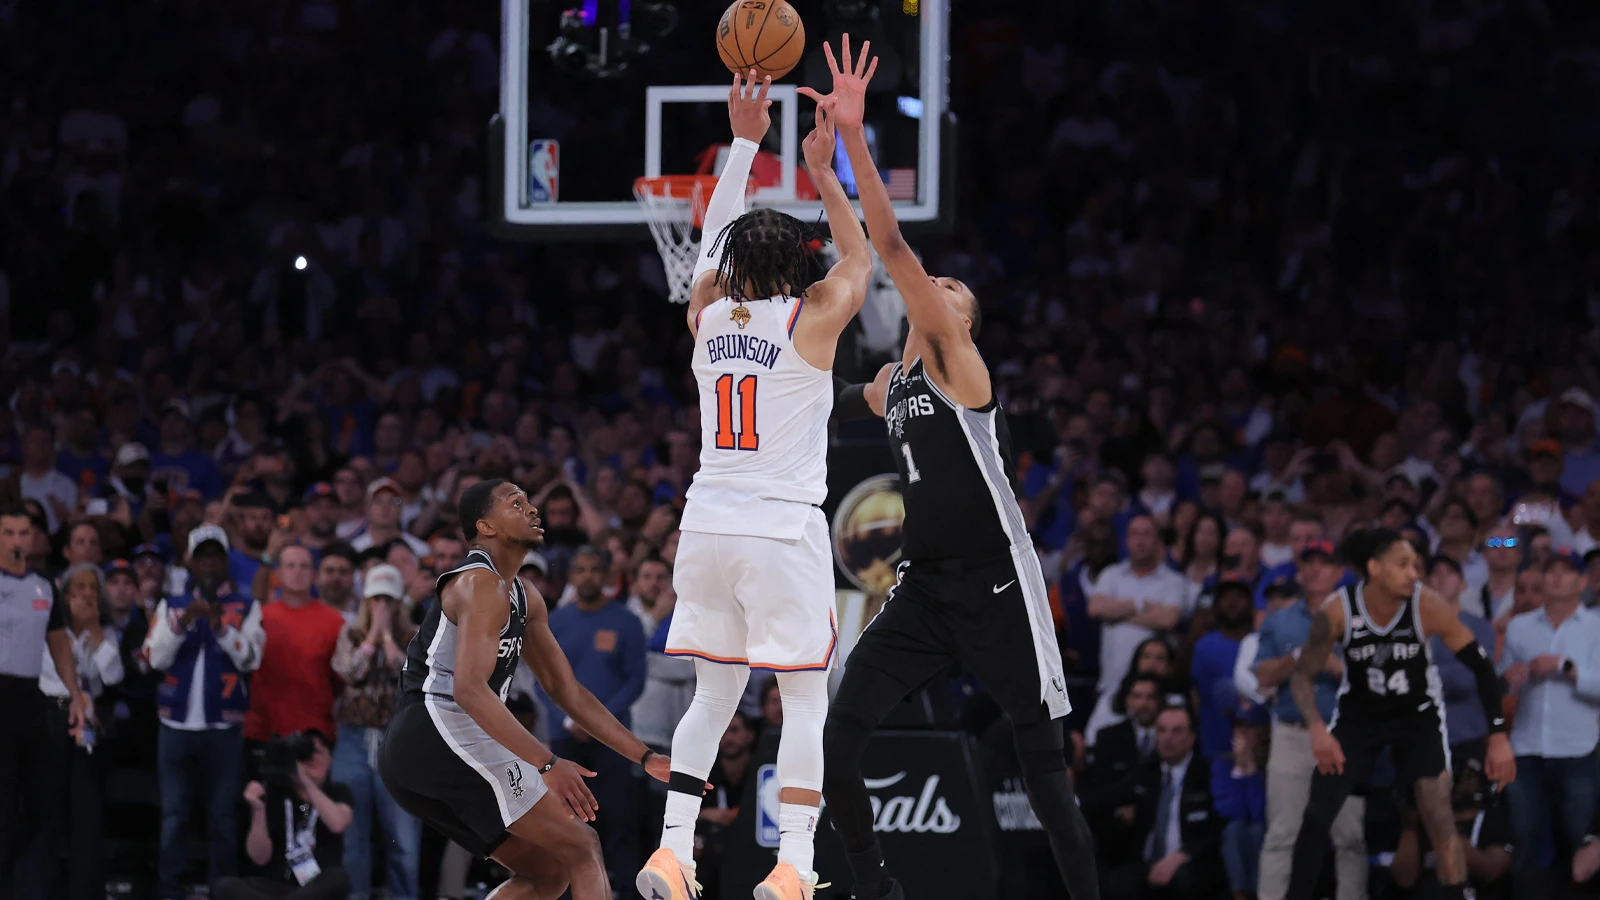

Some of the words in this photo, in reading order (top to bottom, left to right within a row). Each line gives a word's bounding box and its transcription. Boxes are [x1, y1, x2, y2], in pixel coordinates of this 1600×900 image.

[706, 333, 782, 370] BRUNSON
[715, 373, 759, 451] 11
[900, 441, 921, 484] 1
[221, 673, 238, 698] 7
[1366, 667, 1410, 696] 24
